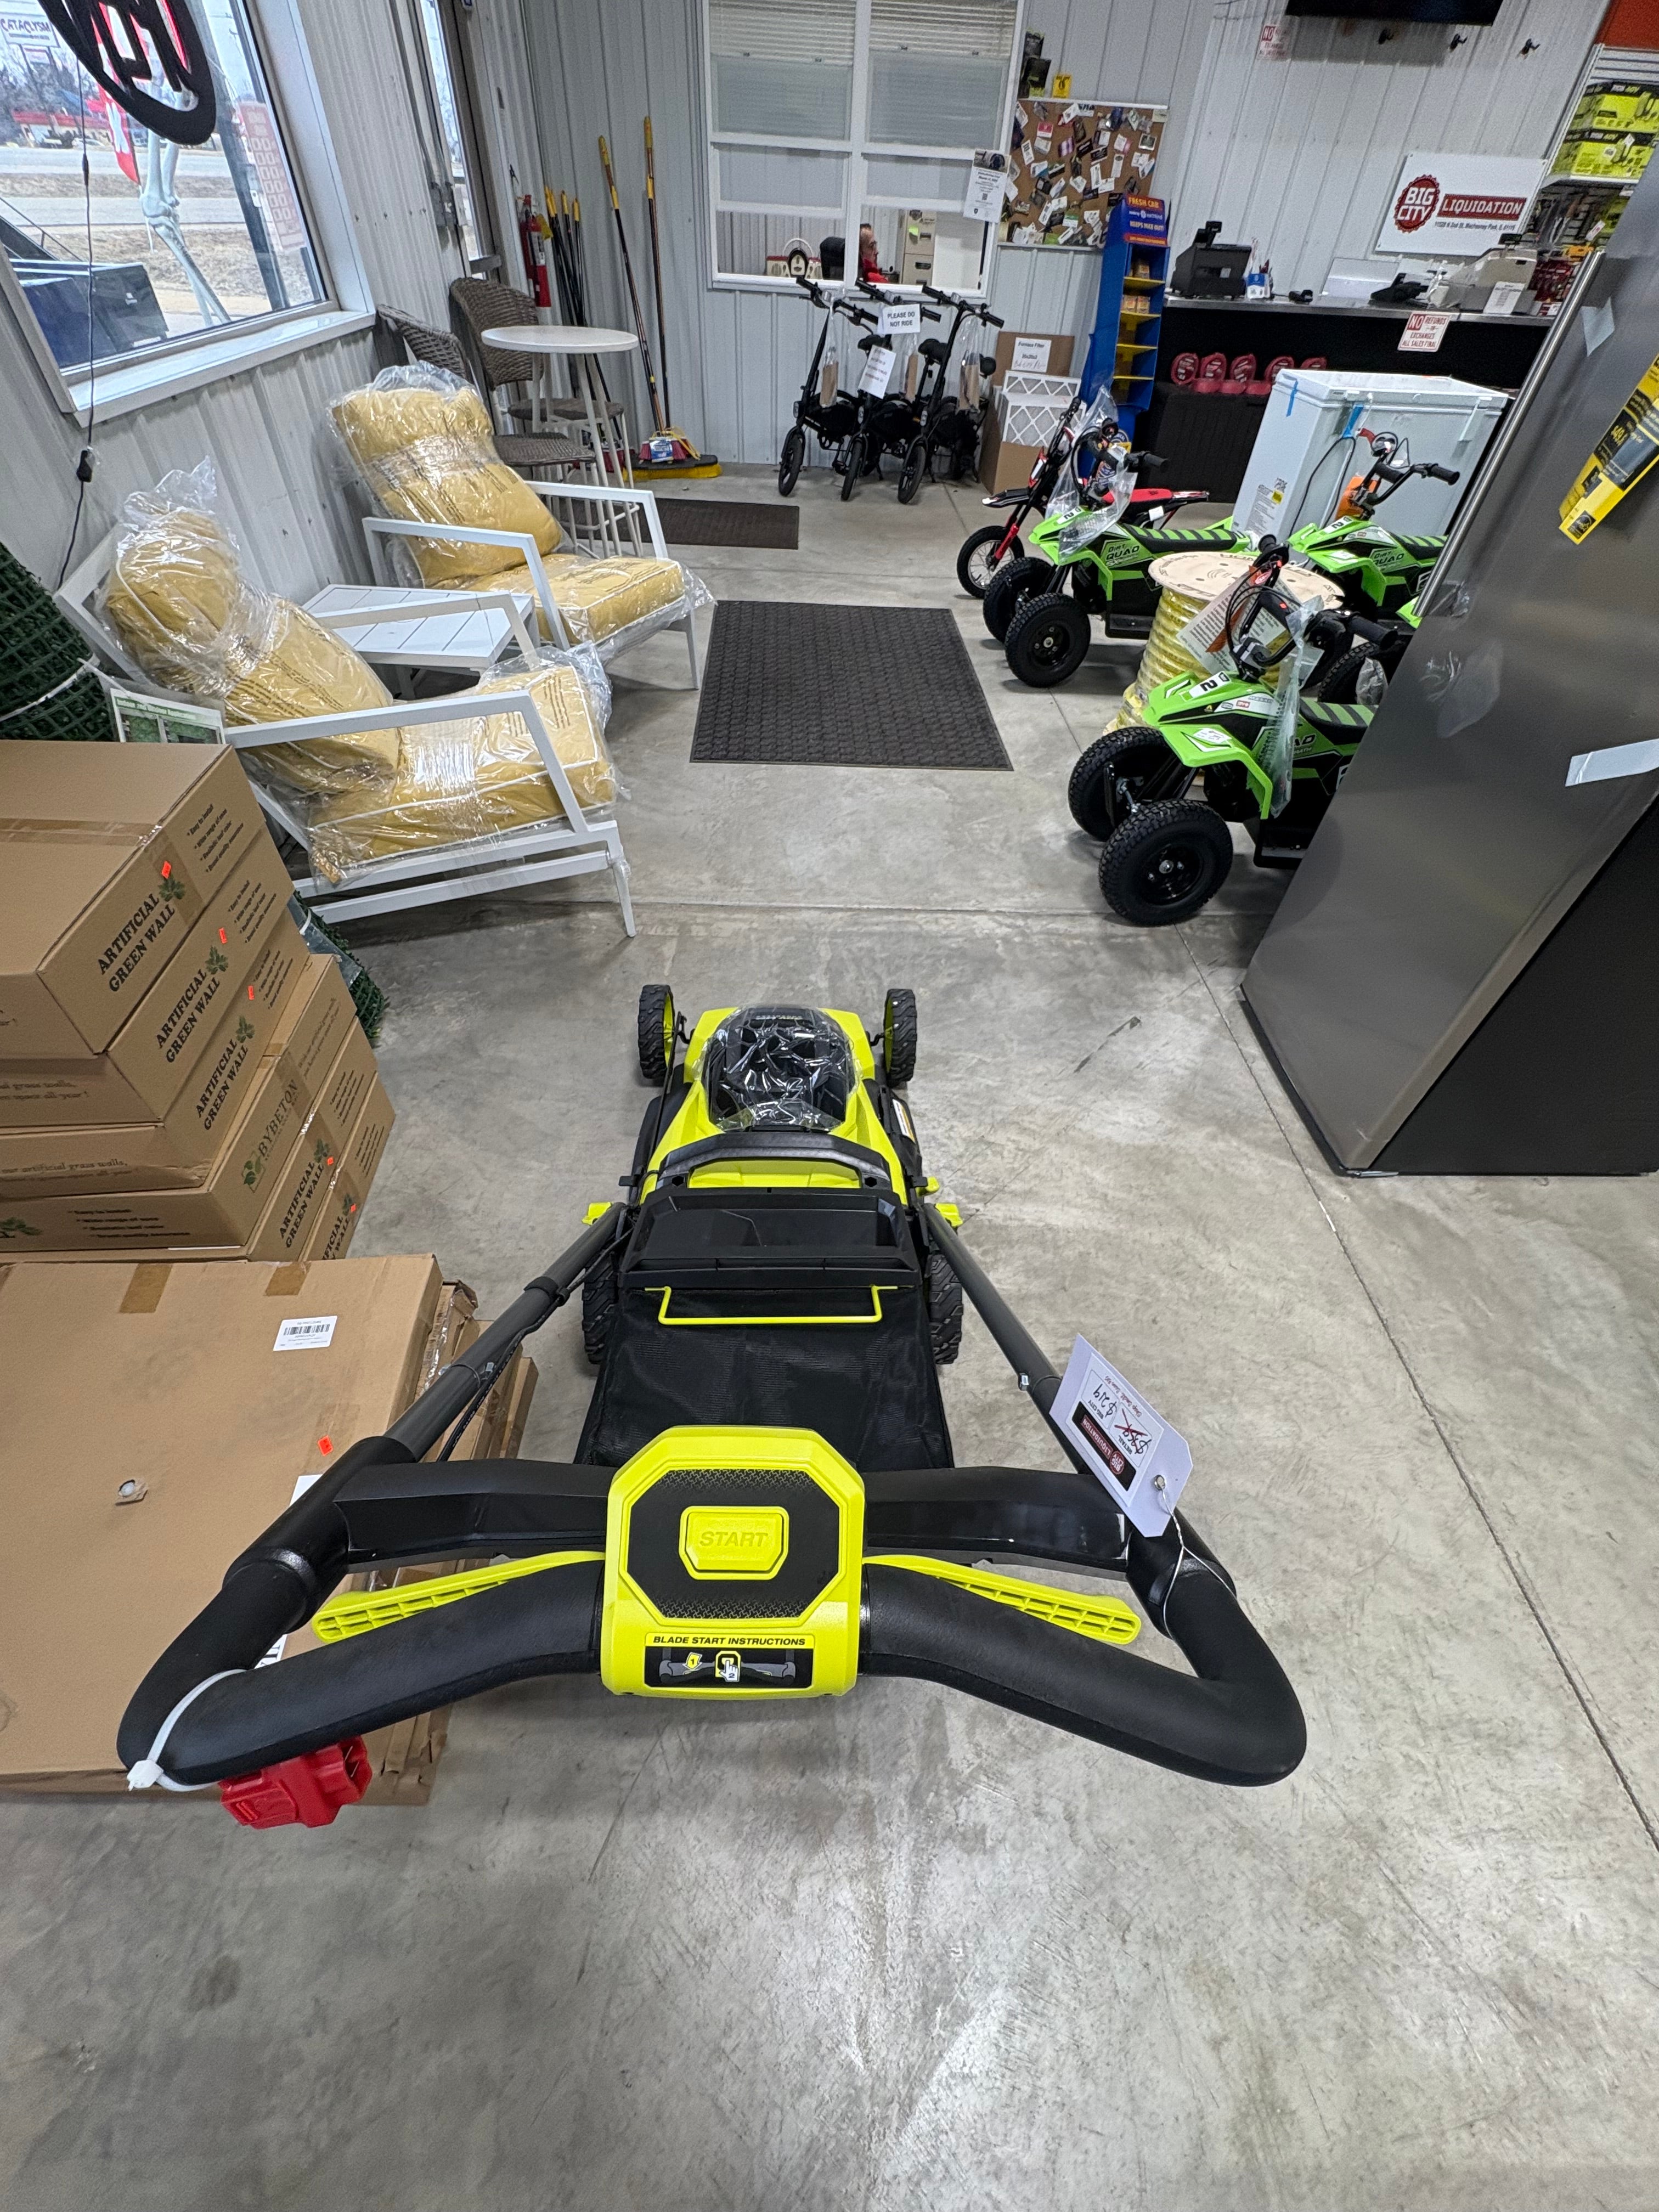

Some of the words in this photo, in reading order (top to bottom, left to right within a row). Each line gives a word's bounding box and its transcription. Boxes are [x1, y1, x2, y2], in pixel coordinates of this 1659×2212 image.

[1, 19, 51, 33] CATACLYSM
[1263, 26, 1274, 40] NO
[1128, 197, 1147, 207] FRESH
[1147, 200, 1159, 208] CAB
[1404, 187, 1436, 206] BIG
[1397, 205, 1432, 221] CITY
[1442, 199, 1523, 216] LIQUIDATION
[1408, 315, 1425, 329] NO
[1425, 317, 1447, 325] REFUNDS
[1063, 512, 1075, 520] 2
[1331, 521, 1345, 529] 2
[1106, 545, 1140, 560] QUAD
[1199, 679, 1218, 692] 2
[98, 893, 159, 975] ARTIFICIAL
[109, 939, 148, 992] GREEN
[144, 904, 175, 943] WALL
[156, 968, 207, 1049] ARTIFICIAL
[166, 1012, 198, 1063] GREEN
[195, 977, 220, 1014] WALL
[196, 1039, 237, 1118] ARTIFICIAL
[204, 1080, 229, 1130] GREEN
[227, 1045, 249, 1081] WALL
[258, 1079, 298, 1158] BYBETON
[21, 1163, 66, 1173] artificial
[279, 1161, 315, 1239] ARTIFICIAL
[285, 1200, 308, 1248] GREEN
[306, 1163, 324, 1199] WALL
[322, 1216, 343, 1260] IFICIAL
[335, 1215, 349, 1251] WALL
[1088, 1400, 1098, 1411] CITY
[1093, 1383, 1118, 1418] $219
[1082, 1418, 1111, 1457] LIQUIDATION
[1119, 1435, 1133, 1455] RETAIL
[1110, 1458, 1121, 1472] BIG
[1113, 1453, 1124, 1466] CITY
[699, 1530, 769, 1548] START
[653, 1636, 689, 1644] BLADE
[691, 1637, 726, 1645] START
[727, 1637, 806, 1646] INSTRUCTIONS
